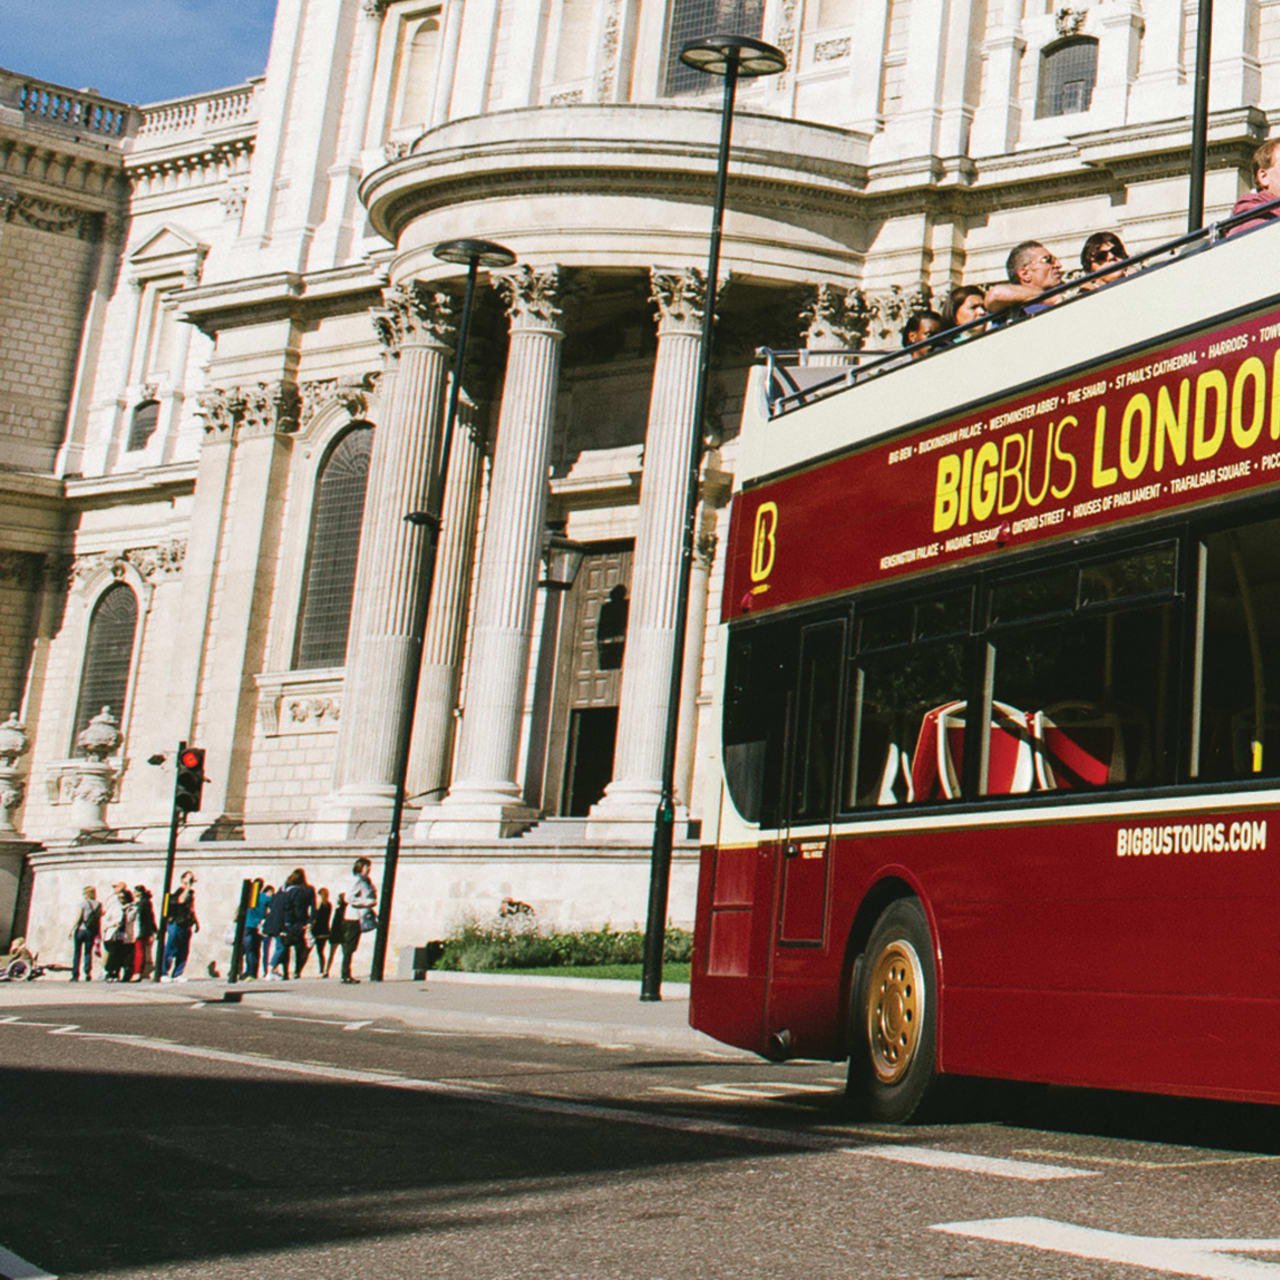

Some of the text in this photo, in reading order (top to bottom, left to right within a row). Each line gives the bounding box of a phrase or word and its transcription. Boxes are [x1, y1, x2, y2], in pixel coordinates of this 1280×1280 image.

[989, 404, 1036, 431] WESTMINSTER
[1036, 396, 1059, 415] ABBEY
[1067, 388, 1082, 405] THE
[1082, 380, 1107, 400] SHARD
[1115, 374, 1126, 390] ST
[1153, 350, 1198, 377] CATHEDRAL
[1208, 333, 1249, 359] HARRODS
[972, 525, 1004, 545] TUSSAU
[1012, 515, 1039, 535] OXFORD
[1039, 508, 1066, 528] STREET
[1073, 498, 1102, 519] HOUSES
[1103, 495, 1113, 511] OF
[1113, 483, 1162, 508] PARLIAMENT
[1170, 471, 1217, 494] TRAFALGAR
[1217, 460, 1251, 483] SQUARE
[1117, 820, 1267, 857] BIGBUSTOURS.COM
